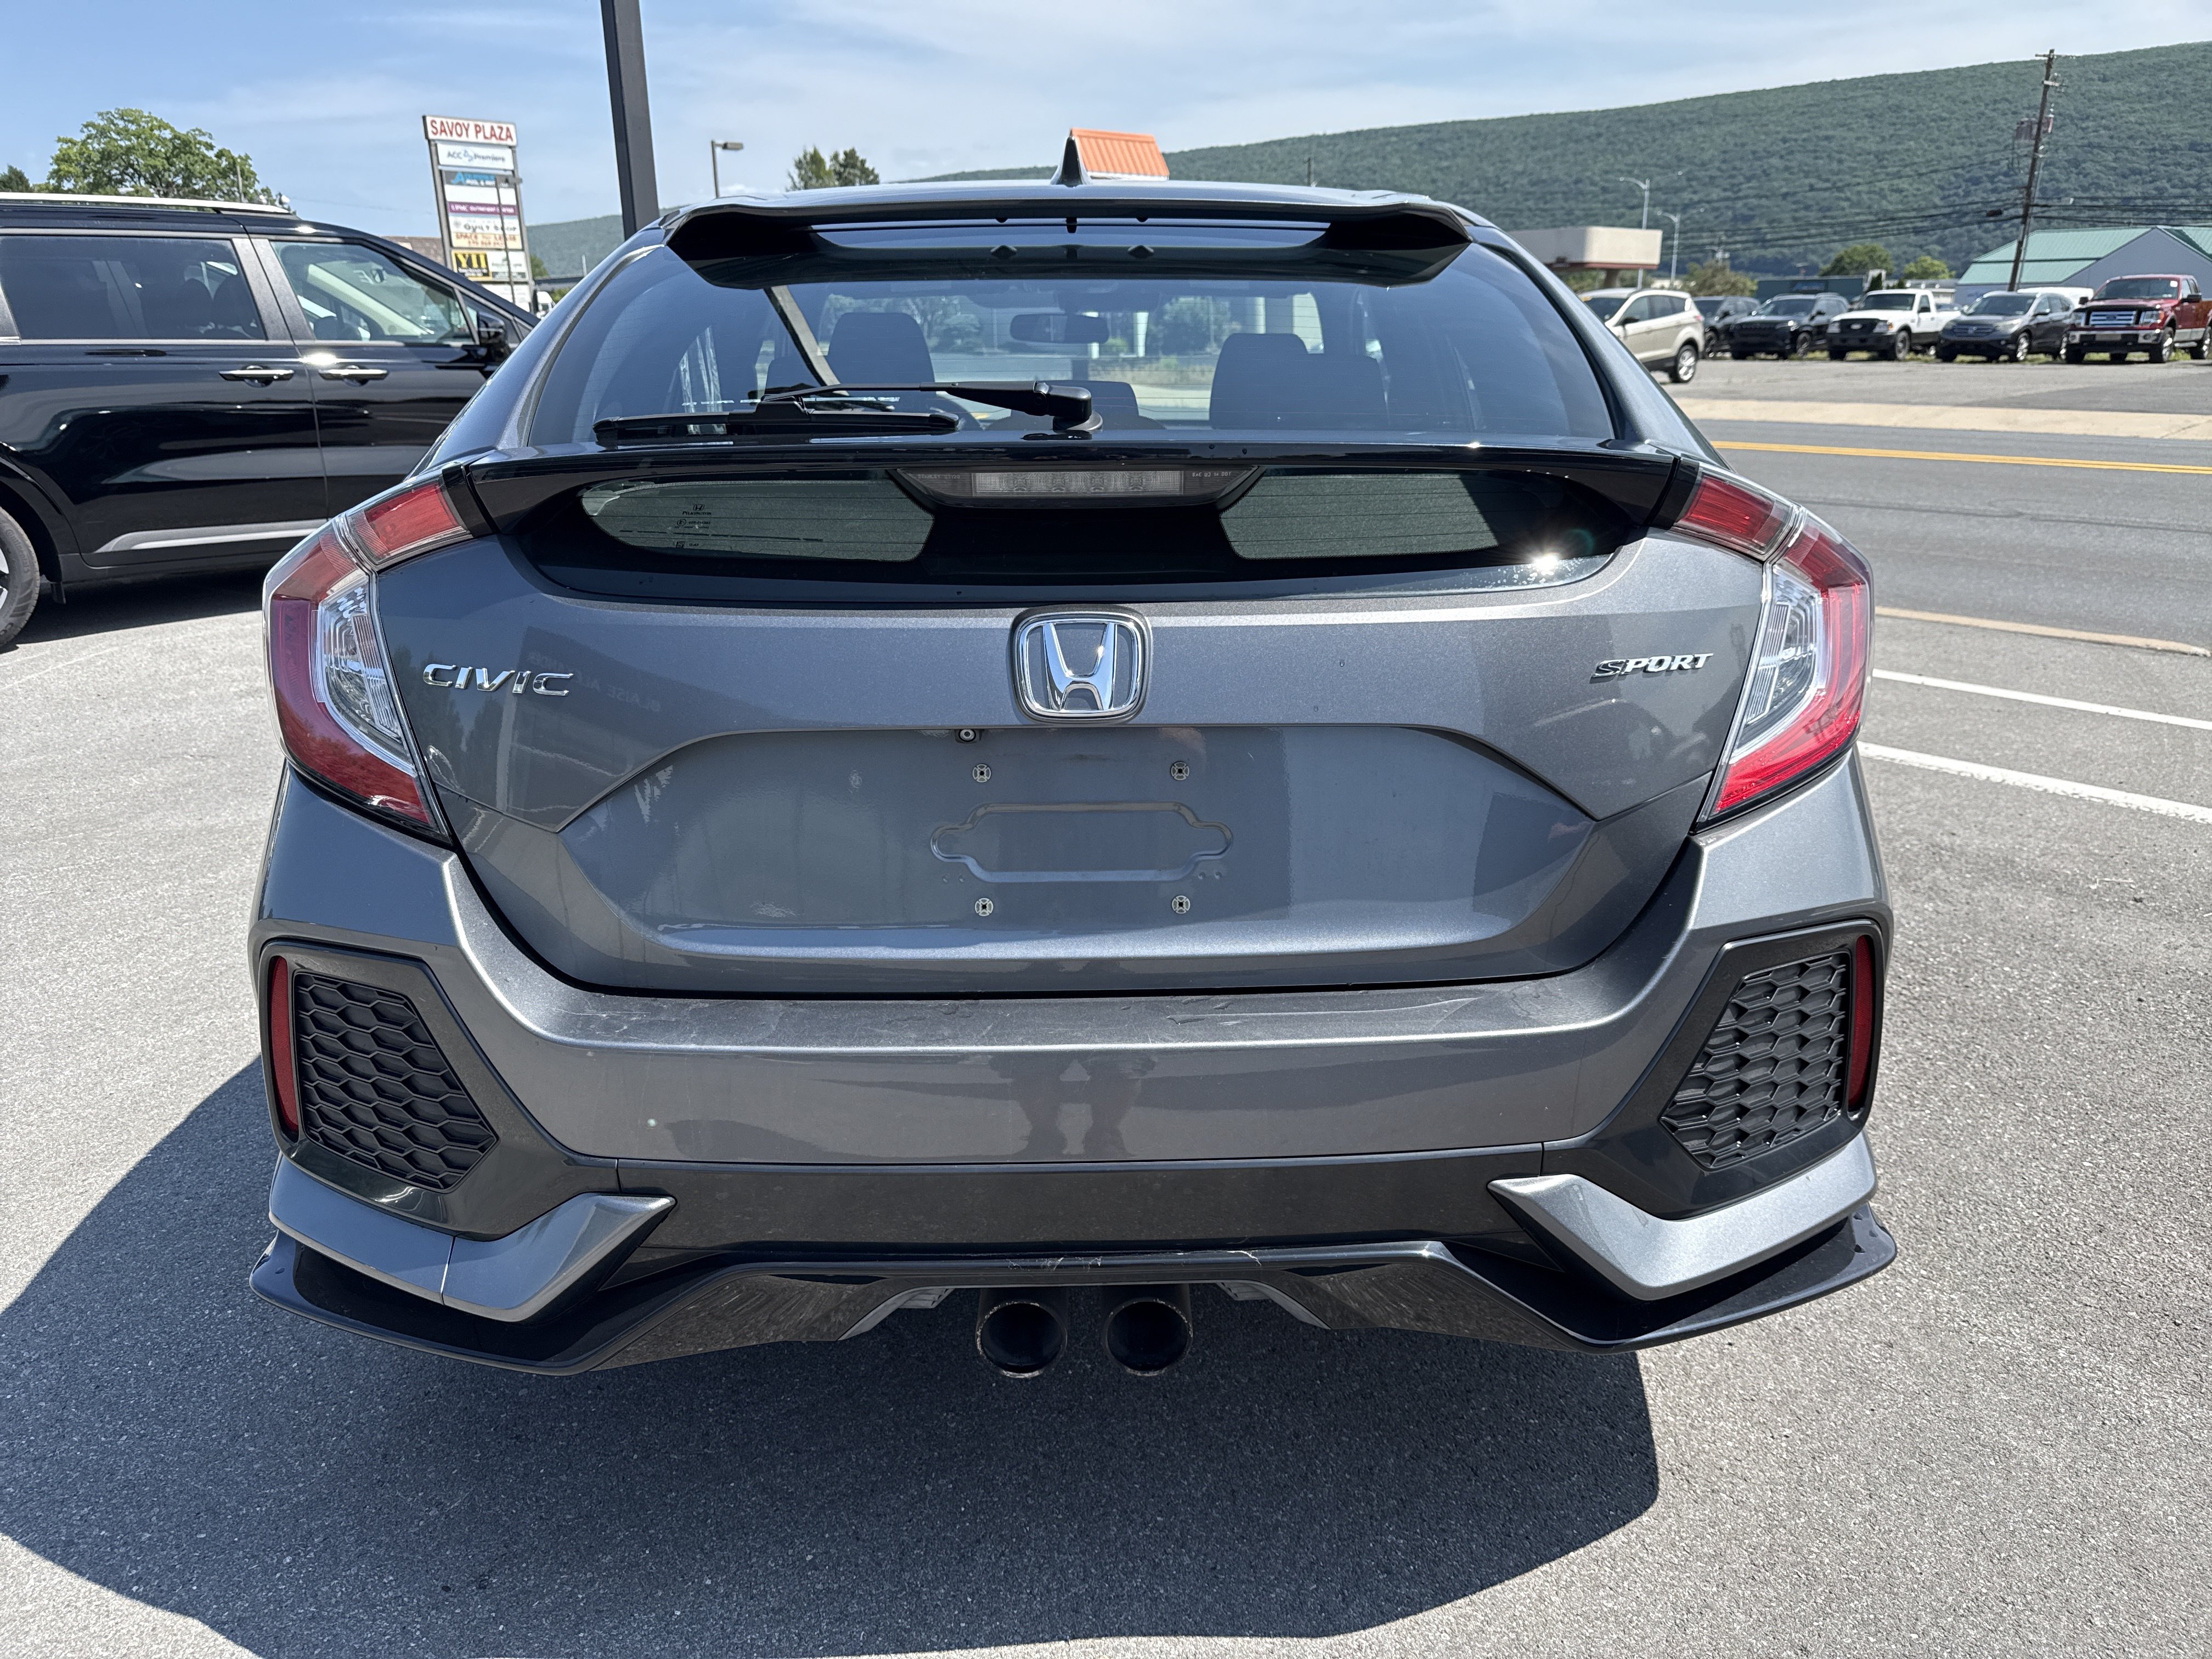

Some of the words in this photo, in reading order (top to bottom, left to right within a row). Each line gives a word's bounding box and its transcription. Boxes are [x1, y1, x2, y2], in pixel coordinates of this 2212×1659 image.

[430, 119, 470, 138] SAVOY
[474, 123, 514, 142] PLAZA
[1592, 653, 1714, 678] SPORT
[422, 663, 574, 696] CIVIC
